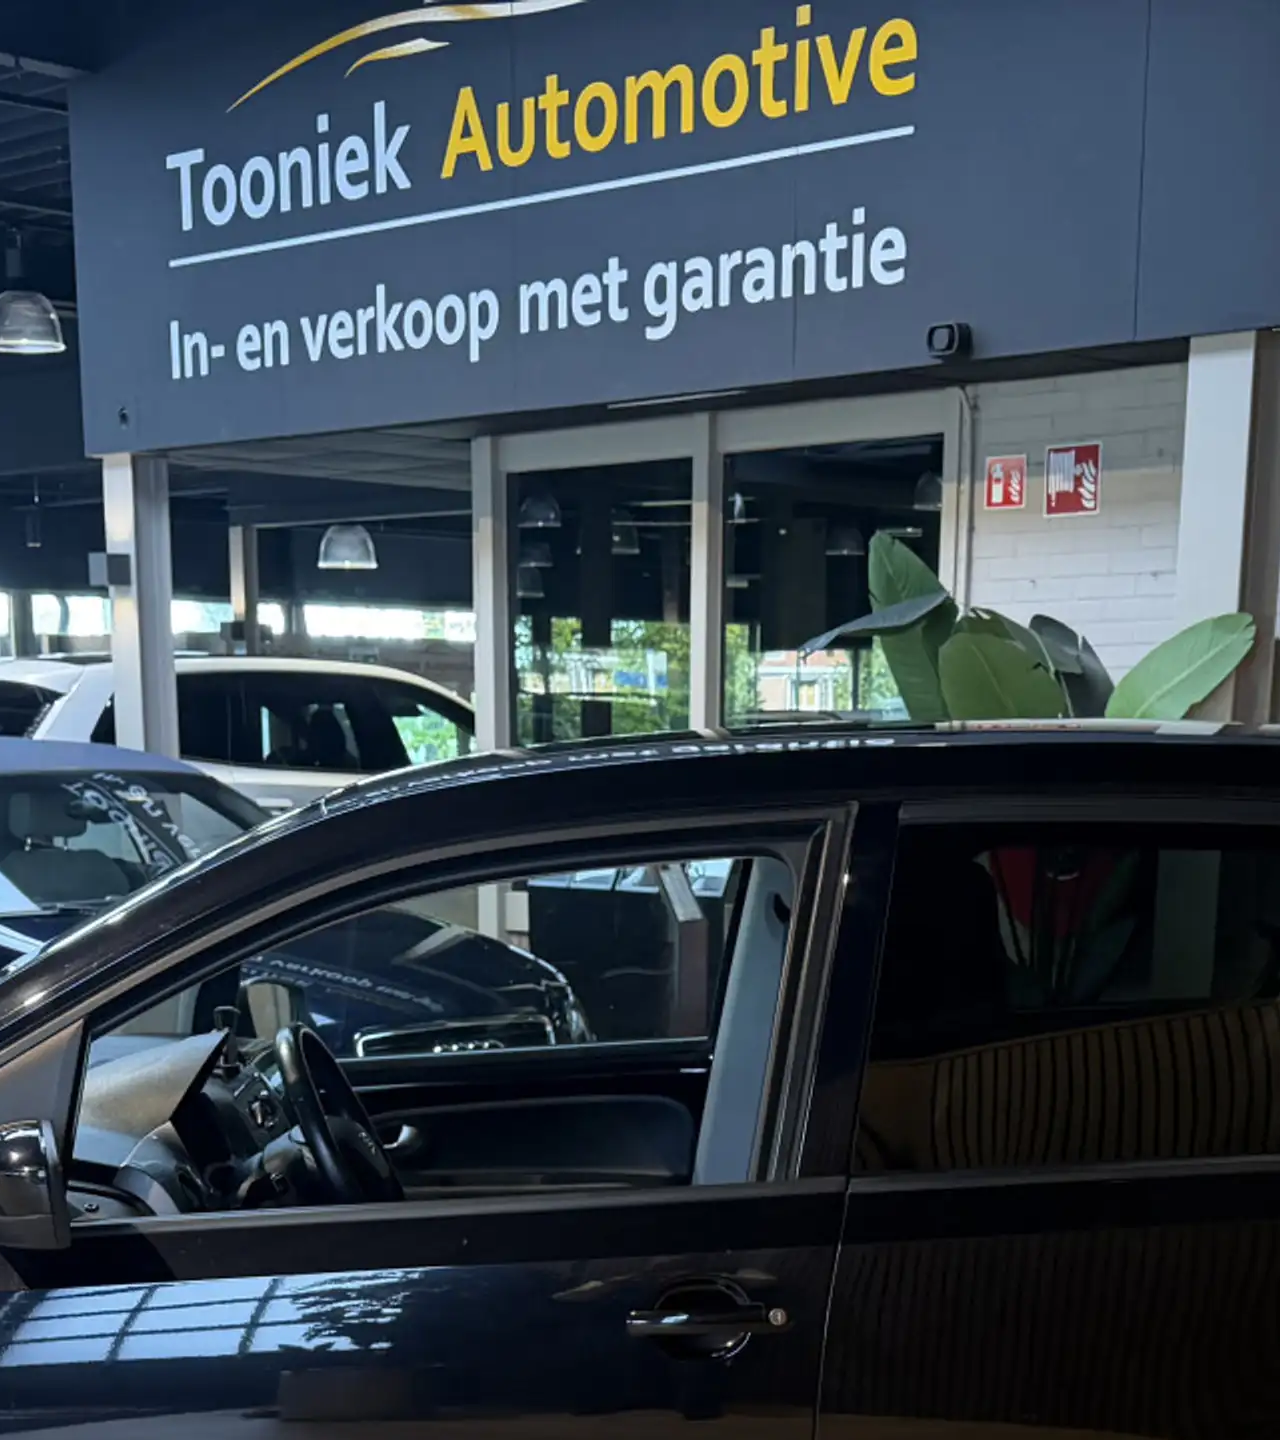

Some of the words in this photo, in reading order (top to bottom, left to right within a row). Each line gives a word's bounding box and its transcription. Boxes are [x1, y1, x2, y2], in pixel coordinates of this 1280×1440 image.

[166, 100, 412, 232] Tooniek
[440, 4, 919, 180] Automotive
[169, 320, 226, 381] In-
[235, 318, 291, 372] en
[300, 283, 500, 364] verkoop
[519, 256, 630, 335] met
[642, 206, 908, 342] garantie
